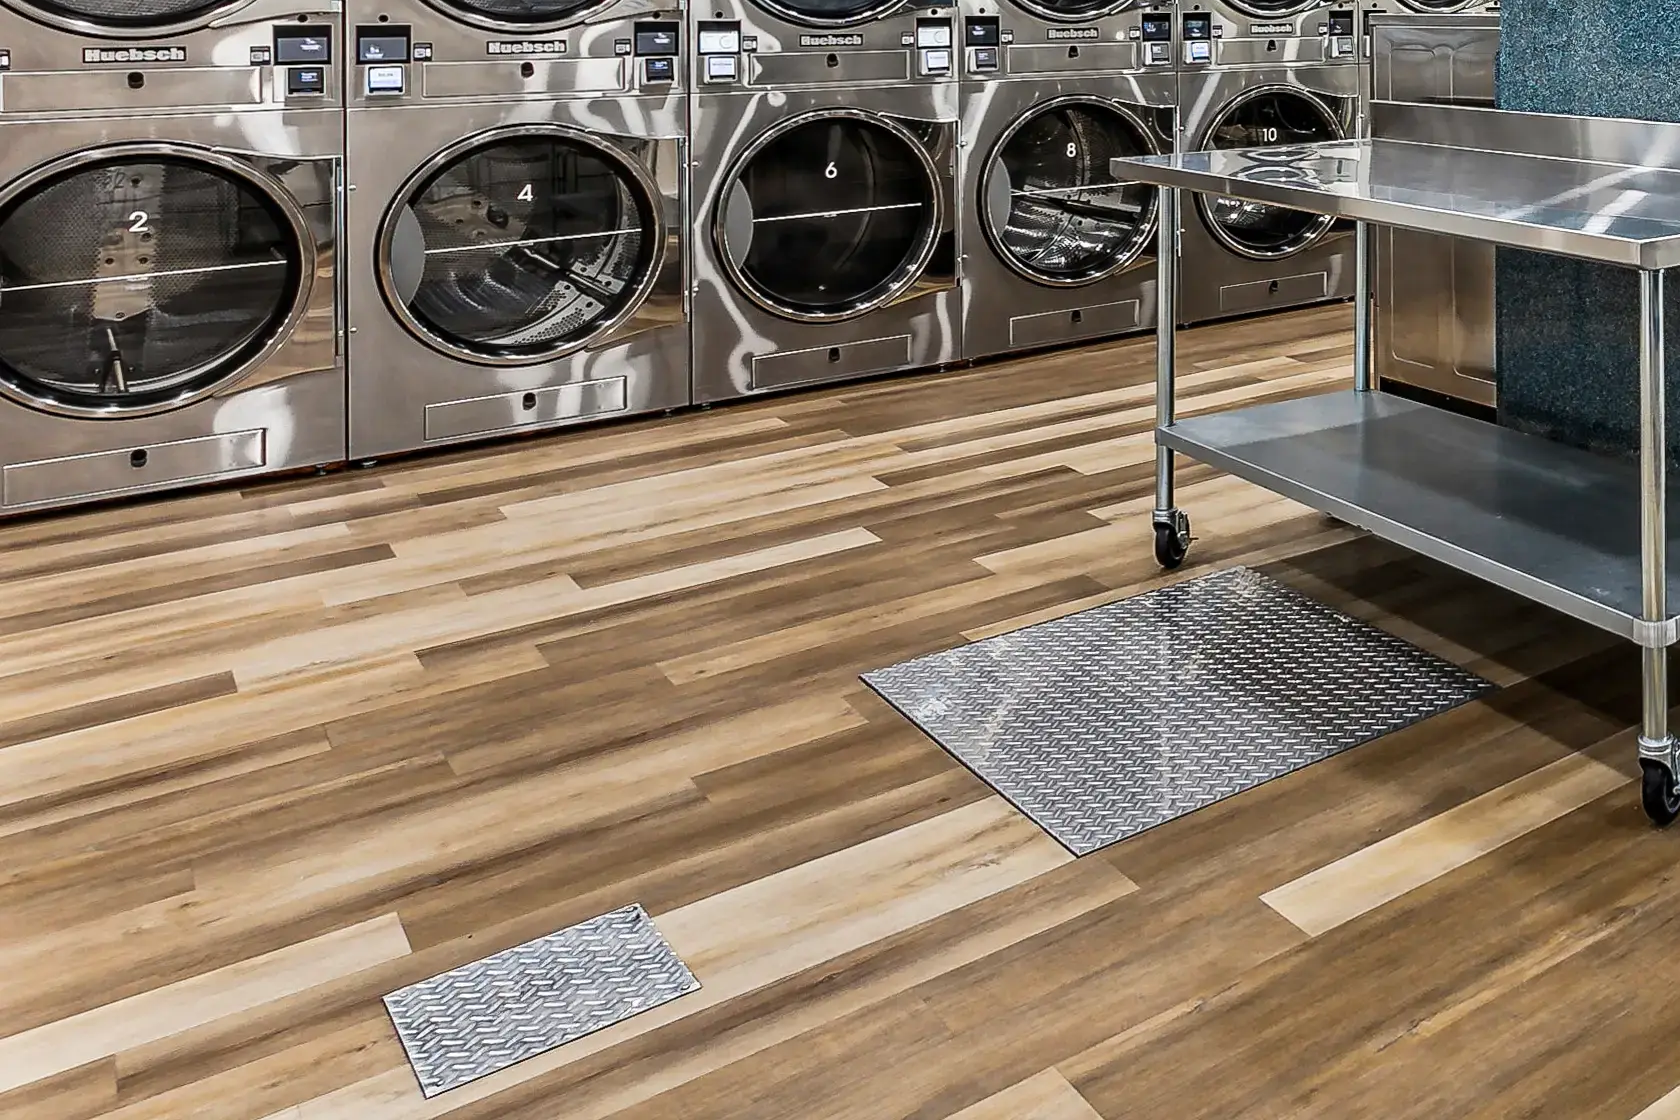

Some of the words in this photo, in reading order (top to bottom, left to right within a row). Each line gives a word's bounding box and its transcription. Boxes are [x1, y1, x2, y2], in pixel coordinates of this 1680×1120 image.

[801, 34, 862, 46] Huebsch
[1048, 28, 1098, 39] Huebsch
[488, 40, 566, 54] Huebsch
[85, 48, 185, 62] Huebsch
[1262, 128, 1277, 142] 10
[1066, 142, 1076, 158] 8
[825, 161, 837, 179] 6
[517, 184, 533, 202] 4
[128, 211, 149, 232] 2
